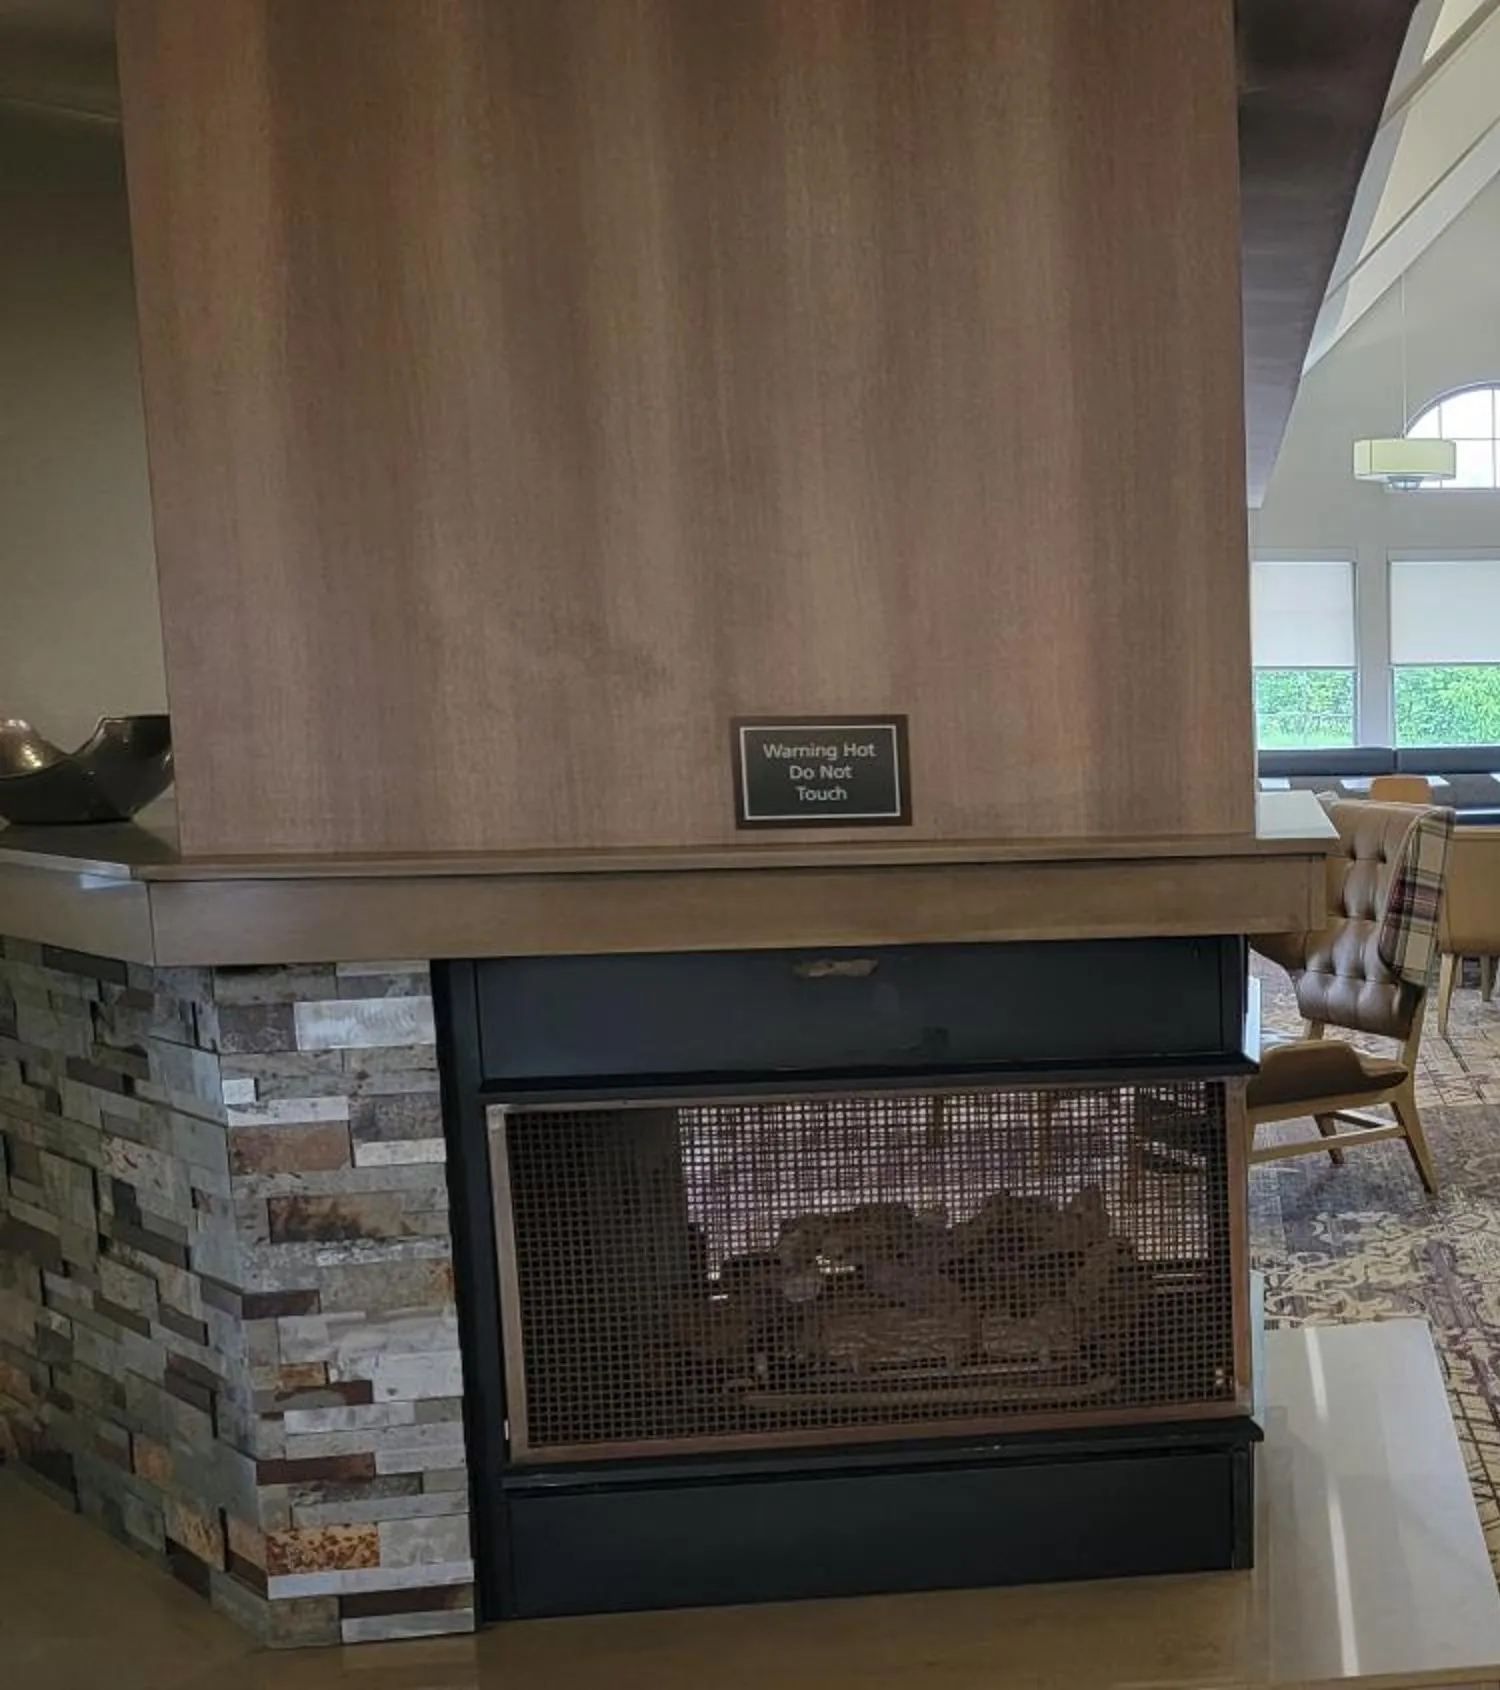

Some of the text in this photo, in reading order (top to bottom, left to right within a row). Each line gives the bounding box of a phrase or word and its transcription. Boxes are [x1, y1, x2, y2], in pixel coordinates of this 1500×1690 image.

[763, 741, 876, 760] Warning Hot
[789, 764, 853, 779] Do Not
[795, 785, 848, 801] Touch
